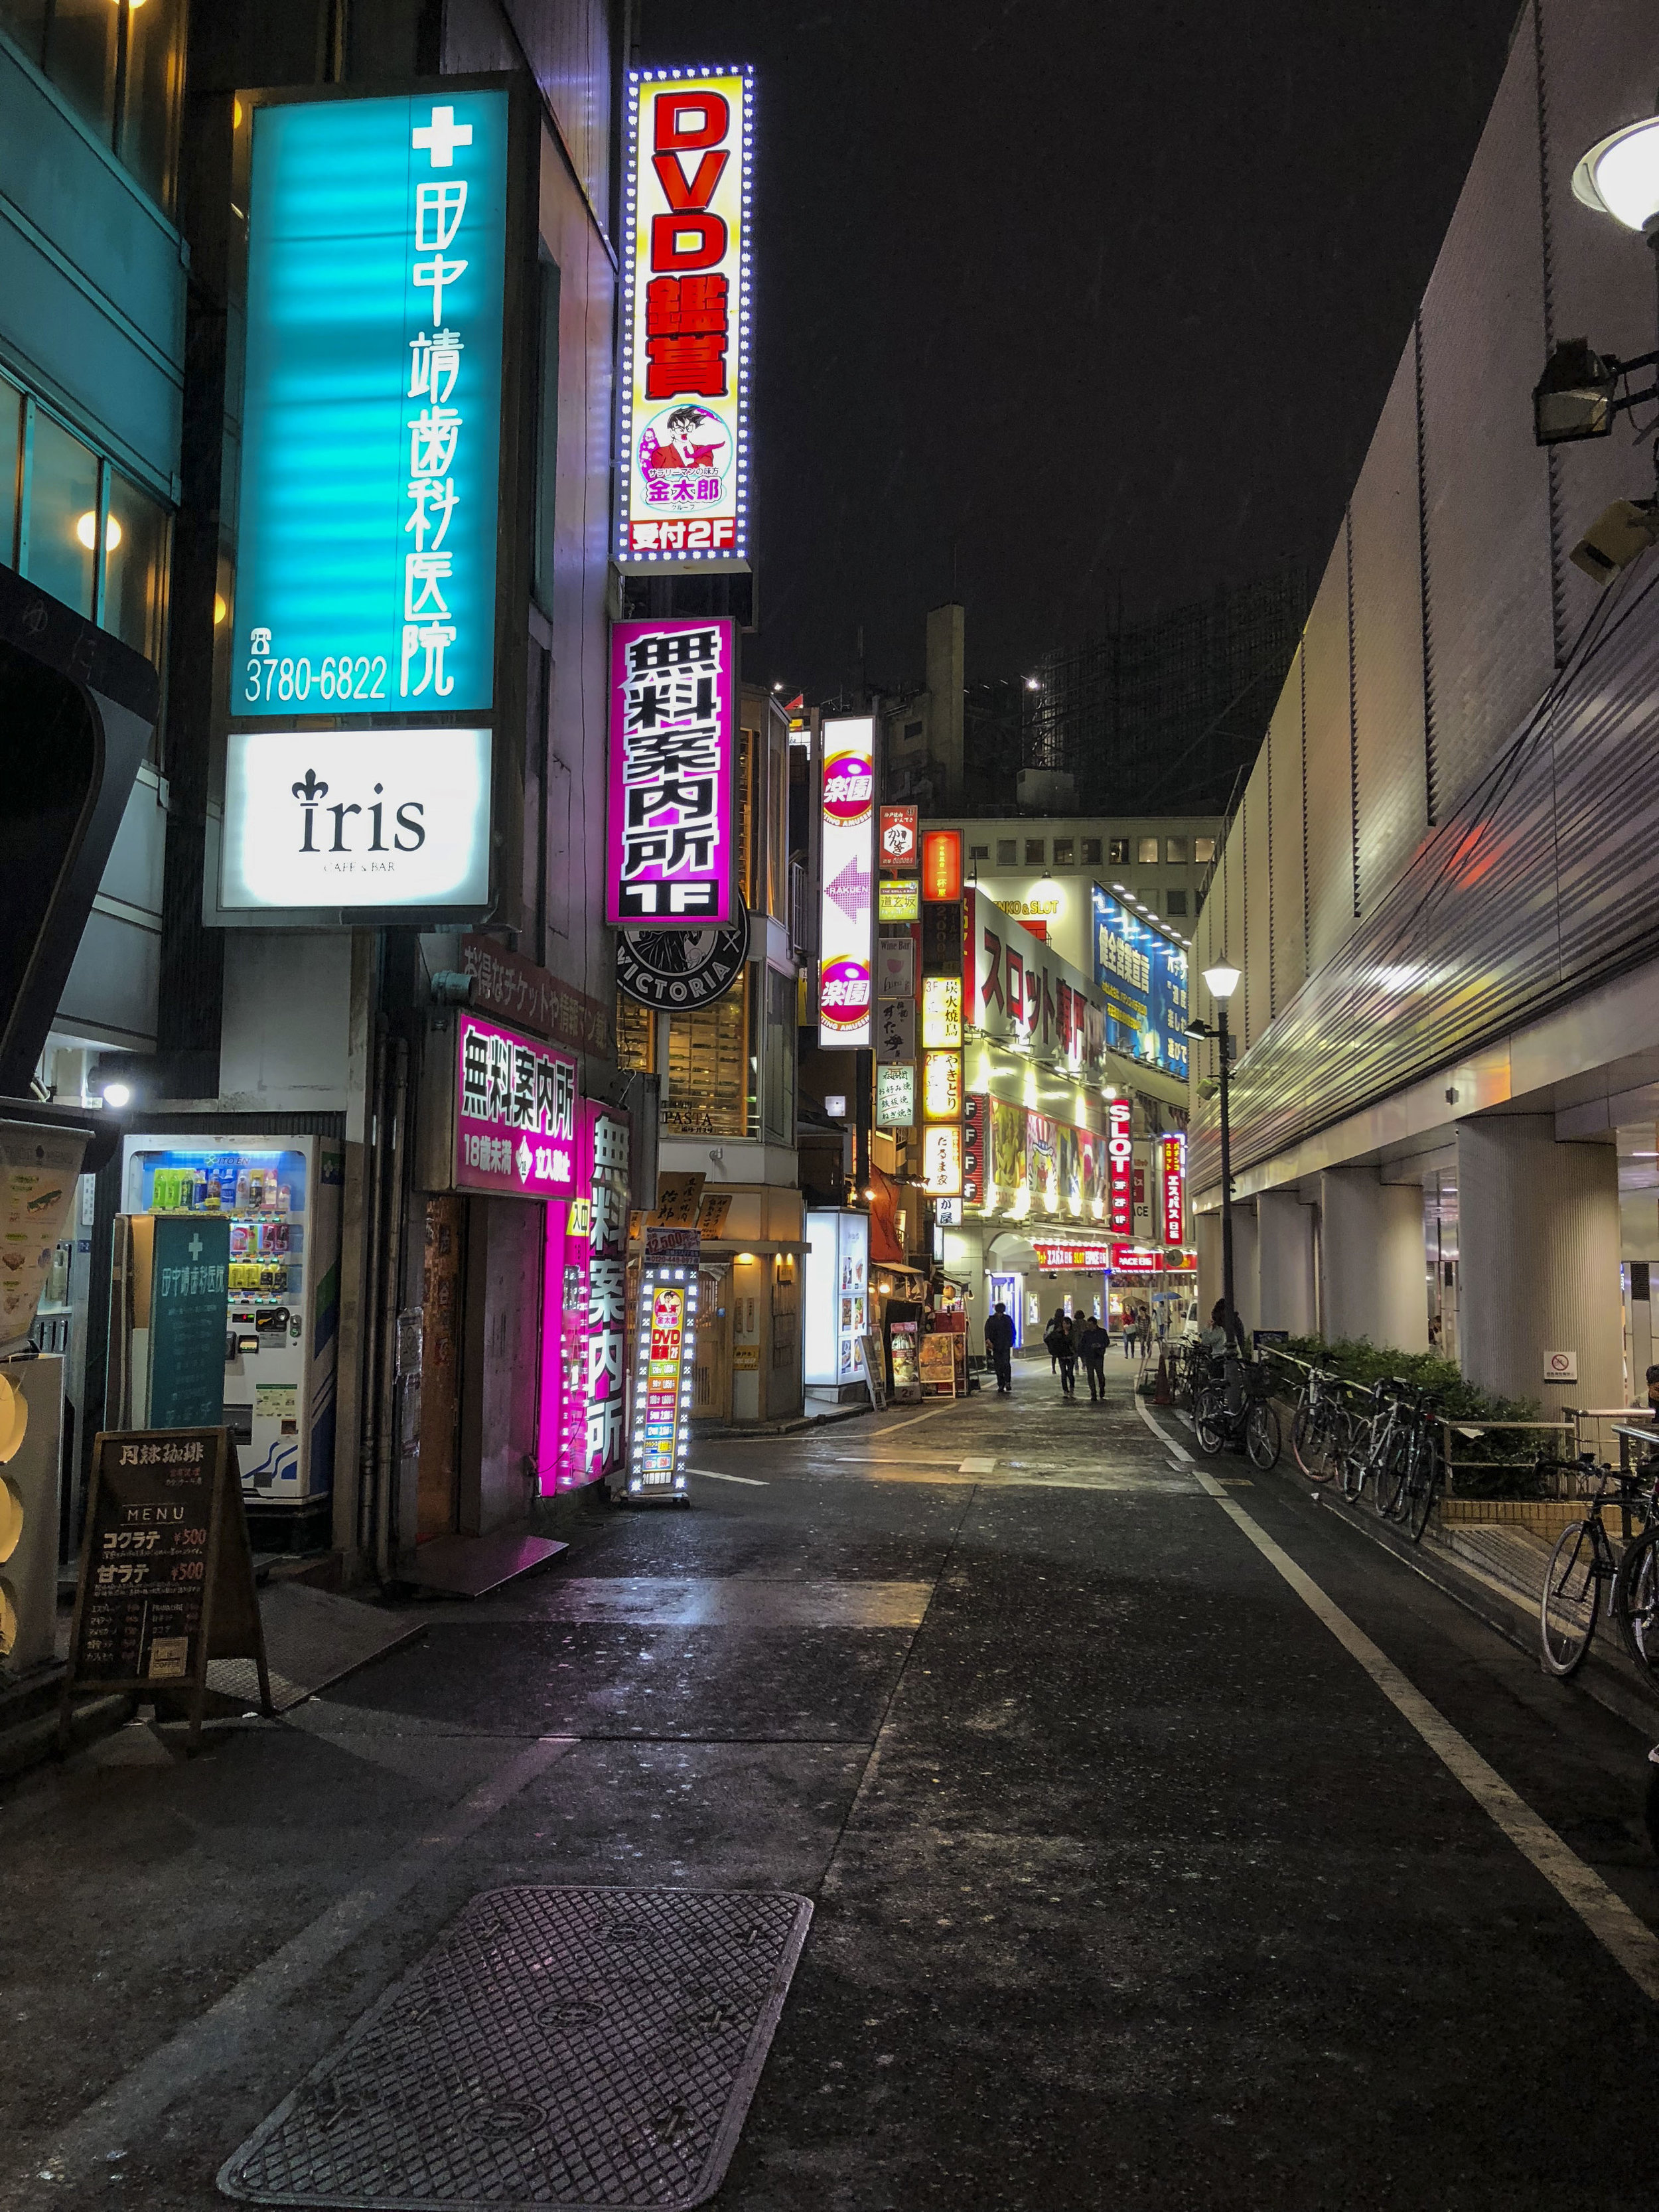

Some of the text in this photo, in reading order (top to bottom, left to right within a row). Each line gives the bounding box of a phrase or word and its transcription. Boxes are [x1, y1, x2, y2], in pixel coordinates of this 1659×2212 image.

[646, 90, 731, 400] DVD鑑賞
[399, 179, 469, 699] 田中靖歯科医院
[649, 467, 719, 478] サラリーマンの味方
[648, 479, 720, 502] 金太郎
[632, 520, 734, 550] 受付2F
[244, 654, 388, 702] 3780-6822
[617, 625, 721, 882] 無料案内所
[823, 774, 873, 803] 楽園
[372, 862, 396, 872] BAR
[625, 884, 711, 915] 1F
[830, 886, 869, 895] RAKUEN
[881, 895, 916, 908] 道玄坂
[1022, 903, 1029, 915] &
[1030, 900, 1059, 915] SLOT
[881, 940, 910, 950] Wine Bar
[1099, 922, 1150, 994] 健全営業宣言
[617, 944, 731, 1002] VICTORIA
[821, 979, 870, 1007] 楽園
[926, 981, 938, 993] 3F
[945, 981, 958, 1037] 炭火焼鳥
[925, 1054, 938, 1067] 2F
[461, 1024, 575, 1141] 無料案内所
[879, 1082, 912, 1096] お好み焼
[946, 1055, 958, 1110] やきとり
[881, 1095, 908, 1108] 鉄板焼
[662, 1110, 713, 1126] PASTA
[882, 1108, 912, 1120] ねぎ焼き
[1108, 1104, 1131, 1173] SLOT
[218, 1157, 251, 1165] ITO EN
[465, 1134, 512, 1175] 18歳未満
[535, 1146, 571, 1183] 立入禁止
[1114, 1198, 1127, 1207] 2F
[573, 1203, 588, 1231] 入口
[1114, 1215, 1127, 1224] 1F
[161, 1265, 225, 1297] 田中靖歯科医院
[585, 1112, 629, 1473] 無料案内所
[652, 1329, 681, 1345] DVD
[670, 1346, 680, 1359] 2F
[127, 1507, 184, 1521] MENU
[103, 1530, 161, 1550] コクラテ
[173, 1528, 207, 1545] ¥500
[97, 1564, 150, 1584] 甘ラテ
[171, 1561, 205, 1581] ¥500
